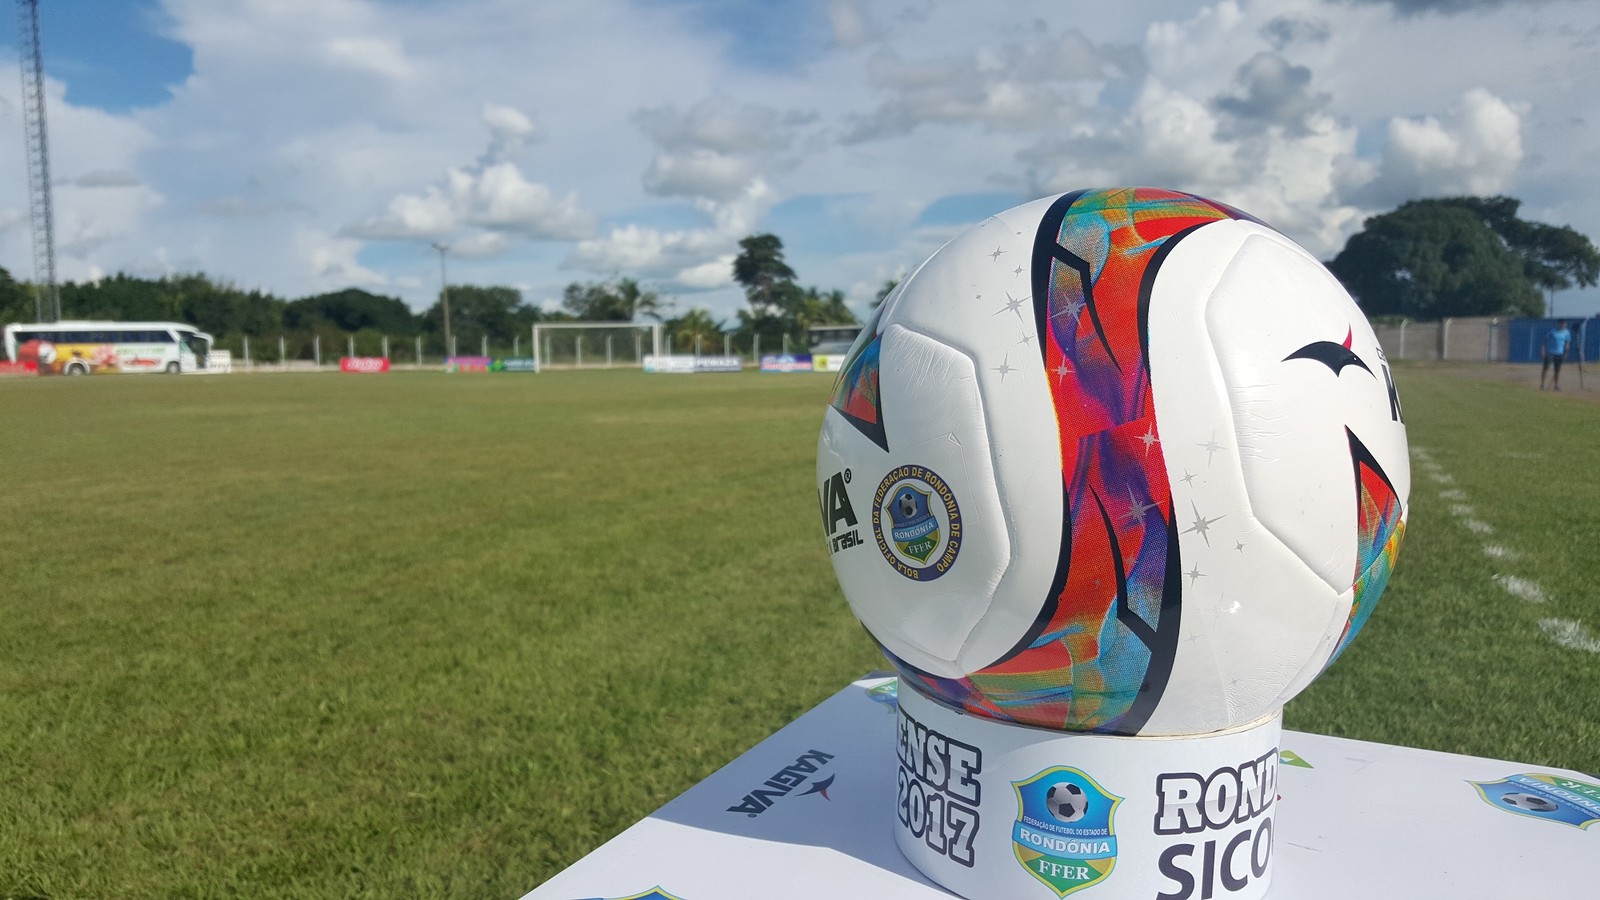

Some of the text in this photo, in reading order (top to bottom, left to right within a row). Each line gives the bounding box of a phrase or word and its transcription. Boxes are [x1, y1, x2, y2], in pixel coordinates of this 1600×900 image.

[911, 467, 923, 478] DE
[873, 511, 880, 524] DA
[951, 523, 960, 538] DE
[875, 527, 896, 564] OFICIAL
[936, 540, 958, 572] CAMPO
[897, 562, 919, 578] BOLA
[896, 704, 982, 807] ENSE
[1153, 746, 1279, 835] ROND
[897, 765, 980, 868] 2017
[1023, 815, 1108, 836] FEDERAÇÃO DE FUTEBOL DO ESTADO DE
[1020, 827, 1111, 854] RONDÔNIA
[1038, 859, 1090, 880] FFER
[1155, 817, 1272, 900] SICO
